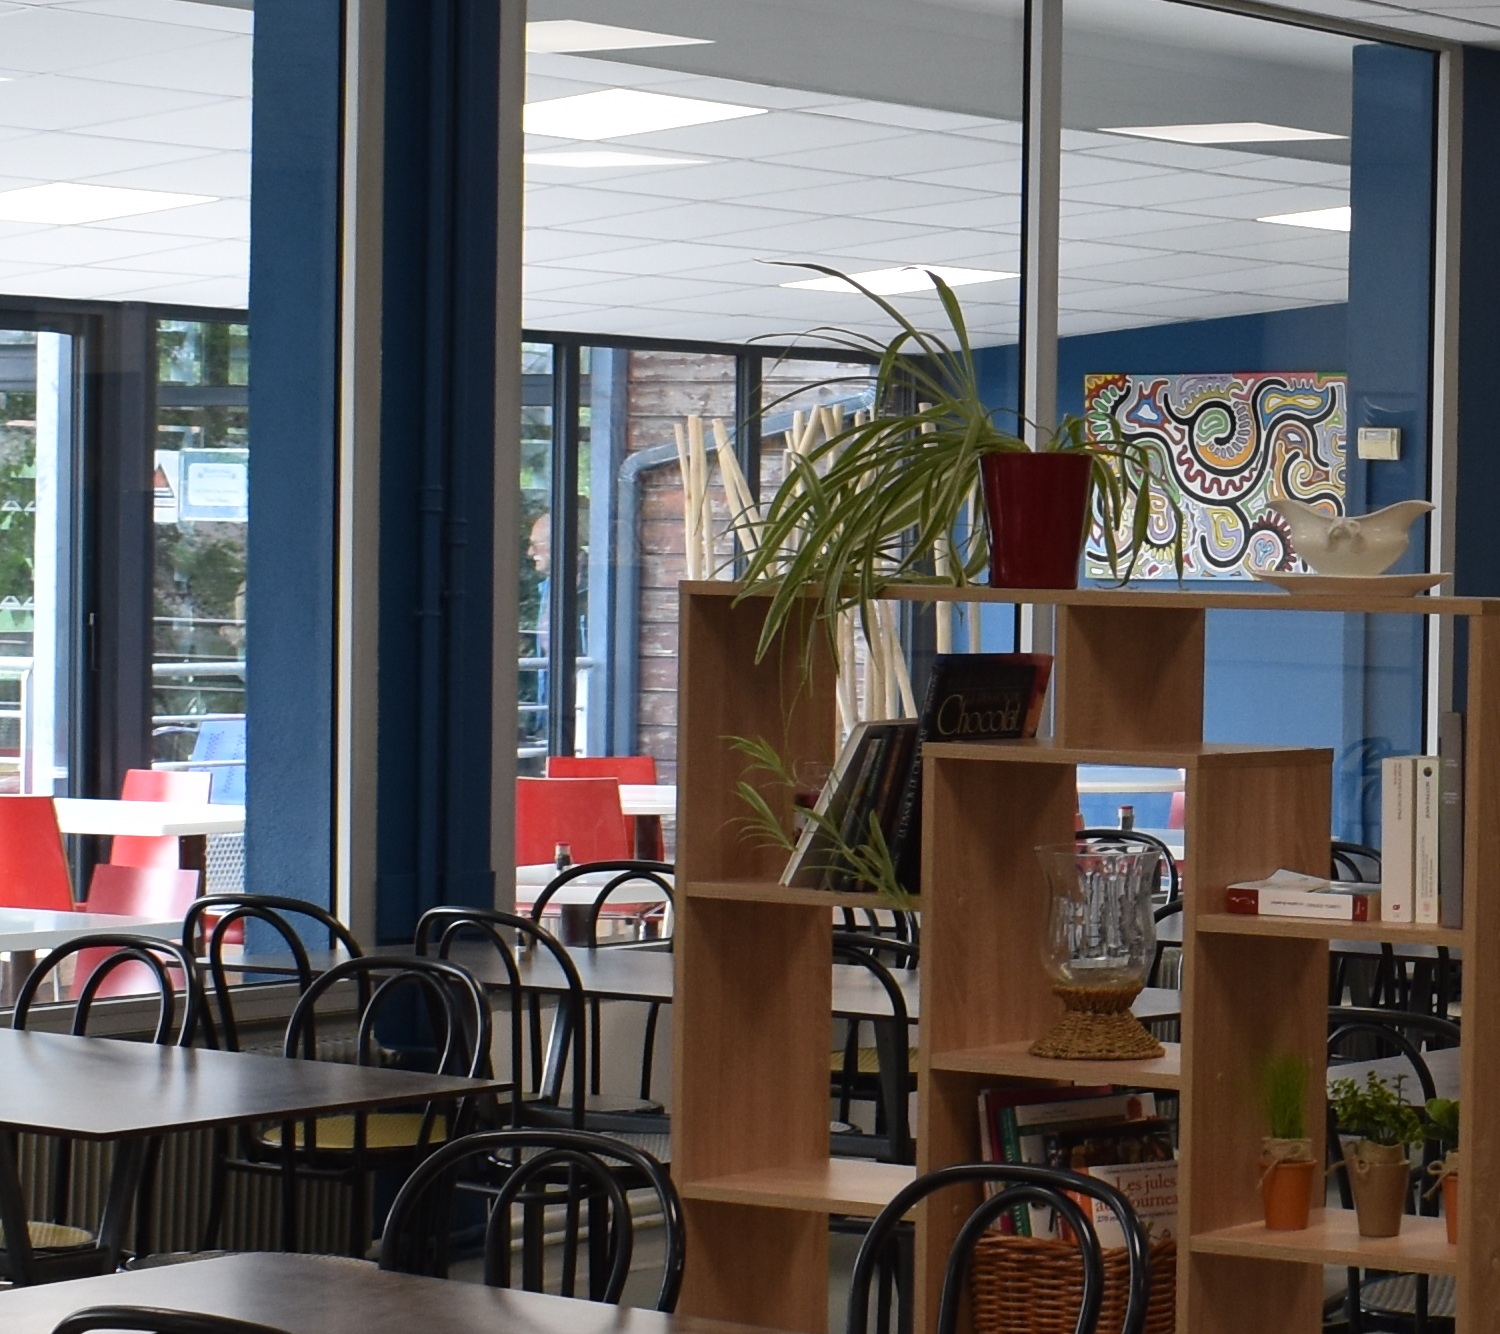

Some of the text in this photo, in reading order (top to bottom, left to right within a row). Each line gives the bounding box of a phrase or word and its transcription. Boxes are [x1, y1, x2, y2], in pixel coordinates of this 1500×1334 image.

[937, 694, 1020, 735] Chocolat
[1115, 1174, 1177, 1194] Les jules
